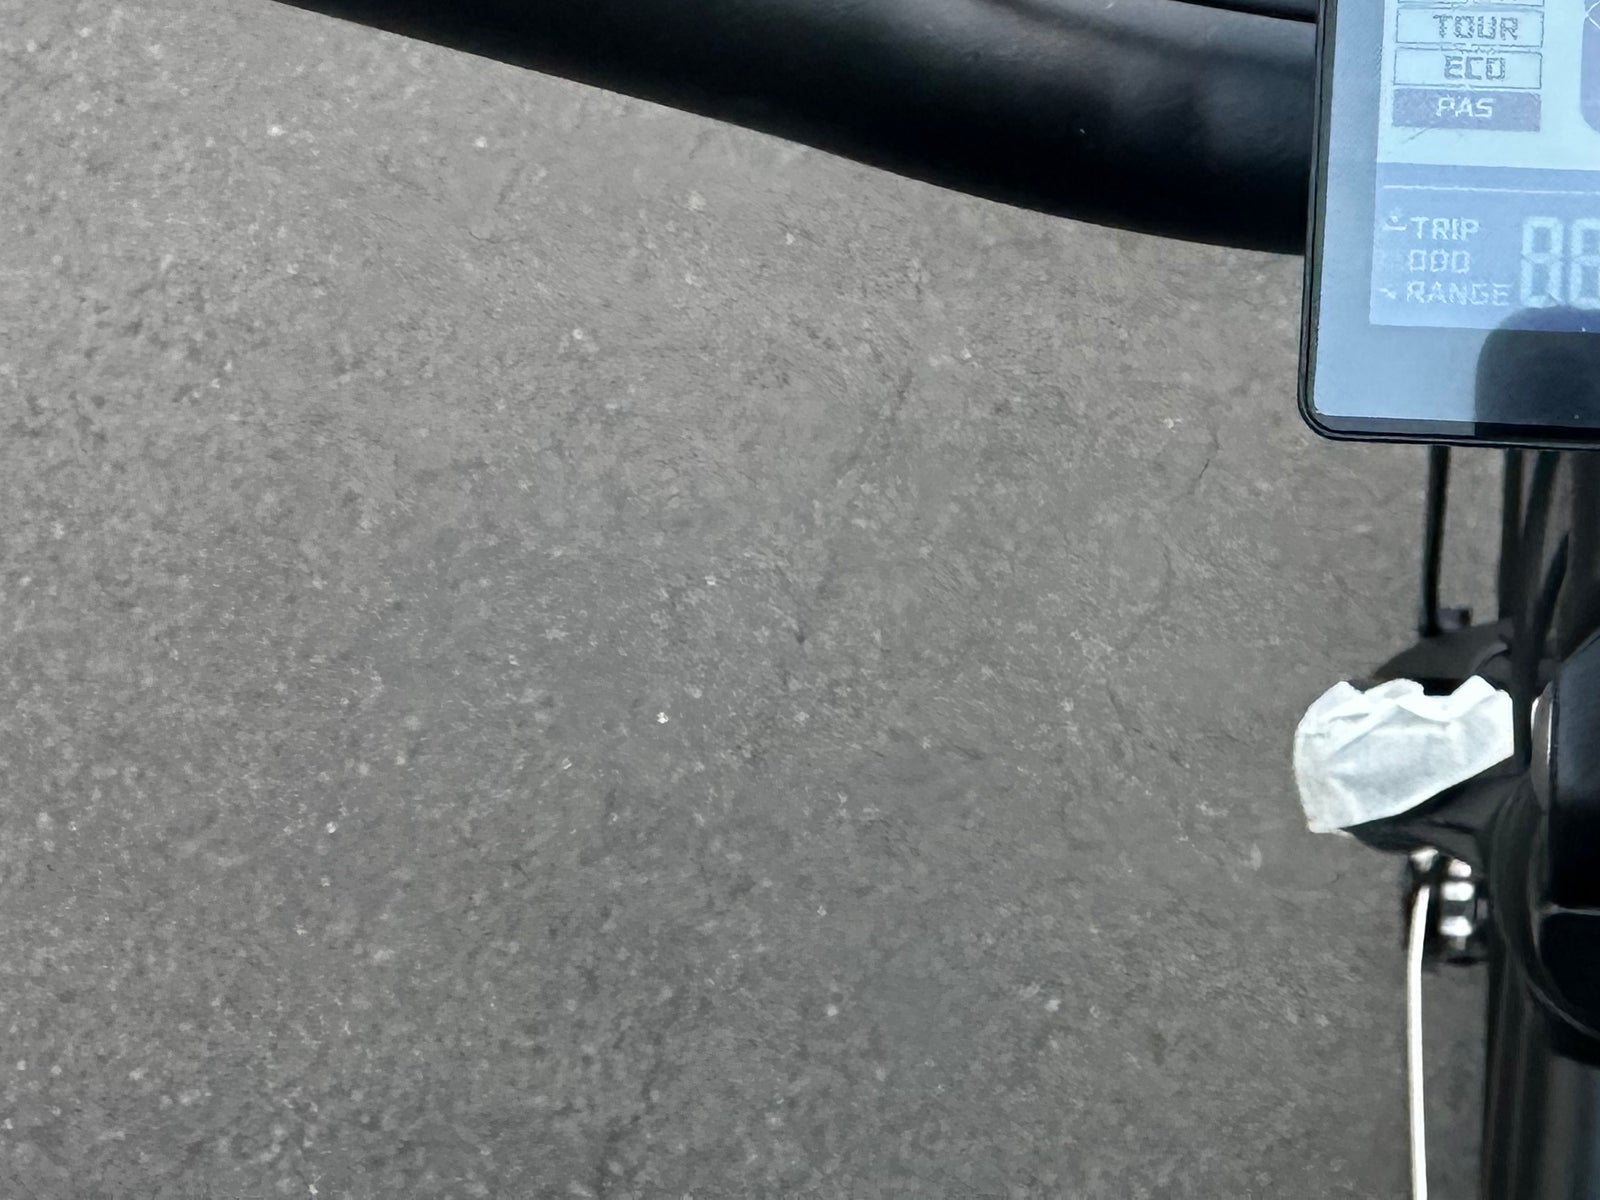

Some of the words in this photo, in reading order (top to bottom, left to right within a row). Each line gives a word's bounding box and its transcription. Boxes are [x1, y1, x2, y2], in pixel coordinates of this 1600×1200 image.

[1432, 14, 1519, 41] TOUR
[1443, 55, 1506, 80] ECO
[1436, 96, 1494, 119] PAS
[1410, 216, 1480, 240] TRIP
[1406, 281, 1511, 305] RANGE
